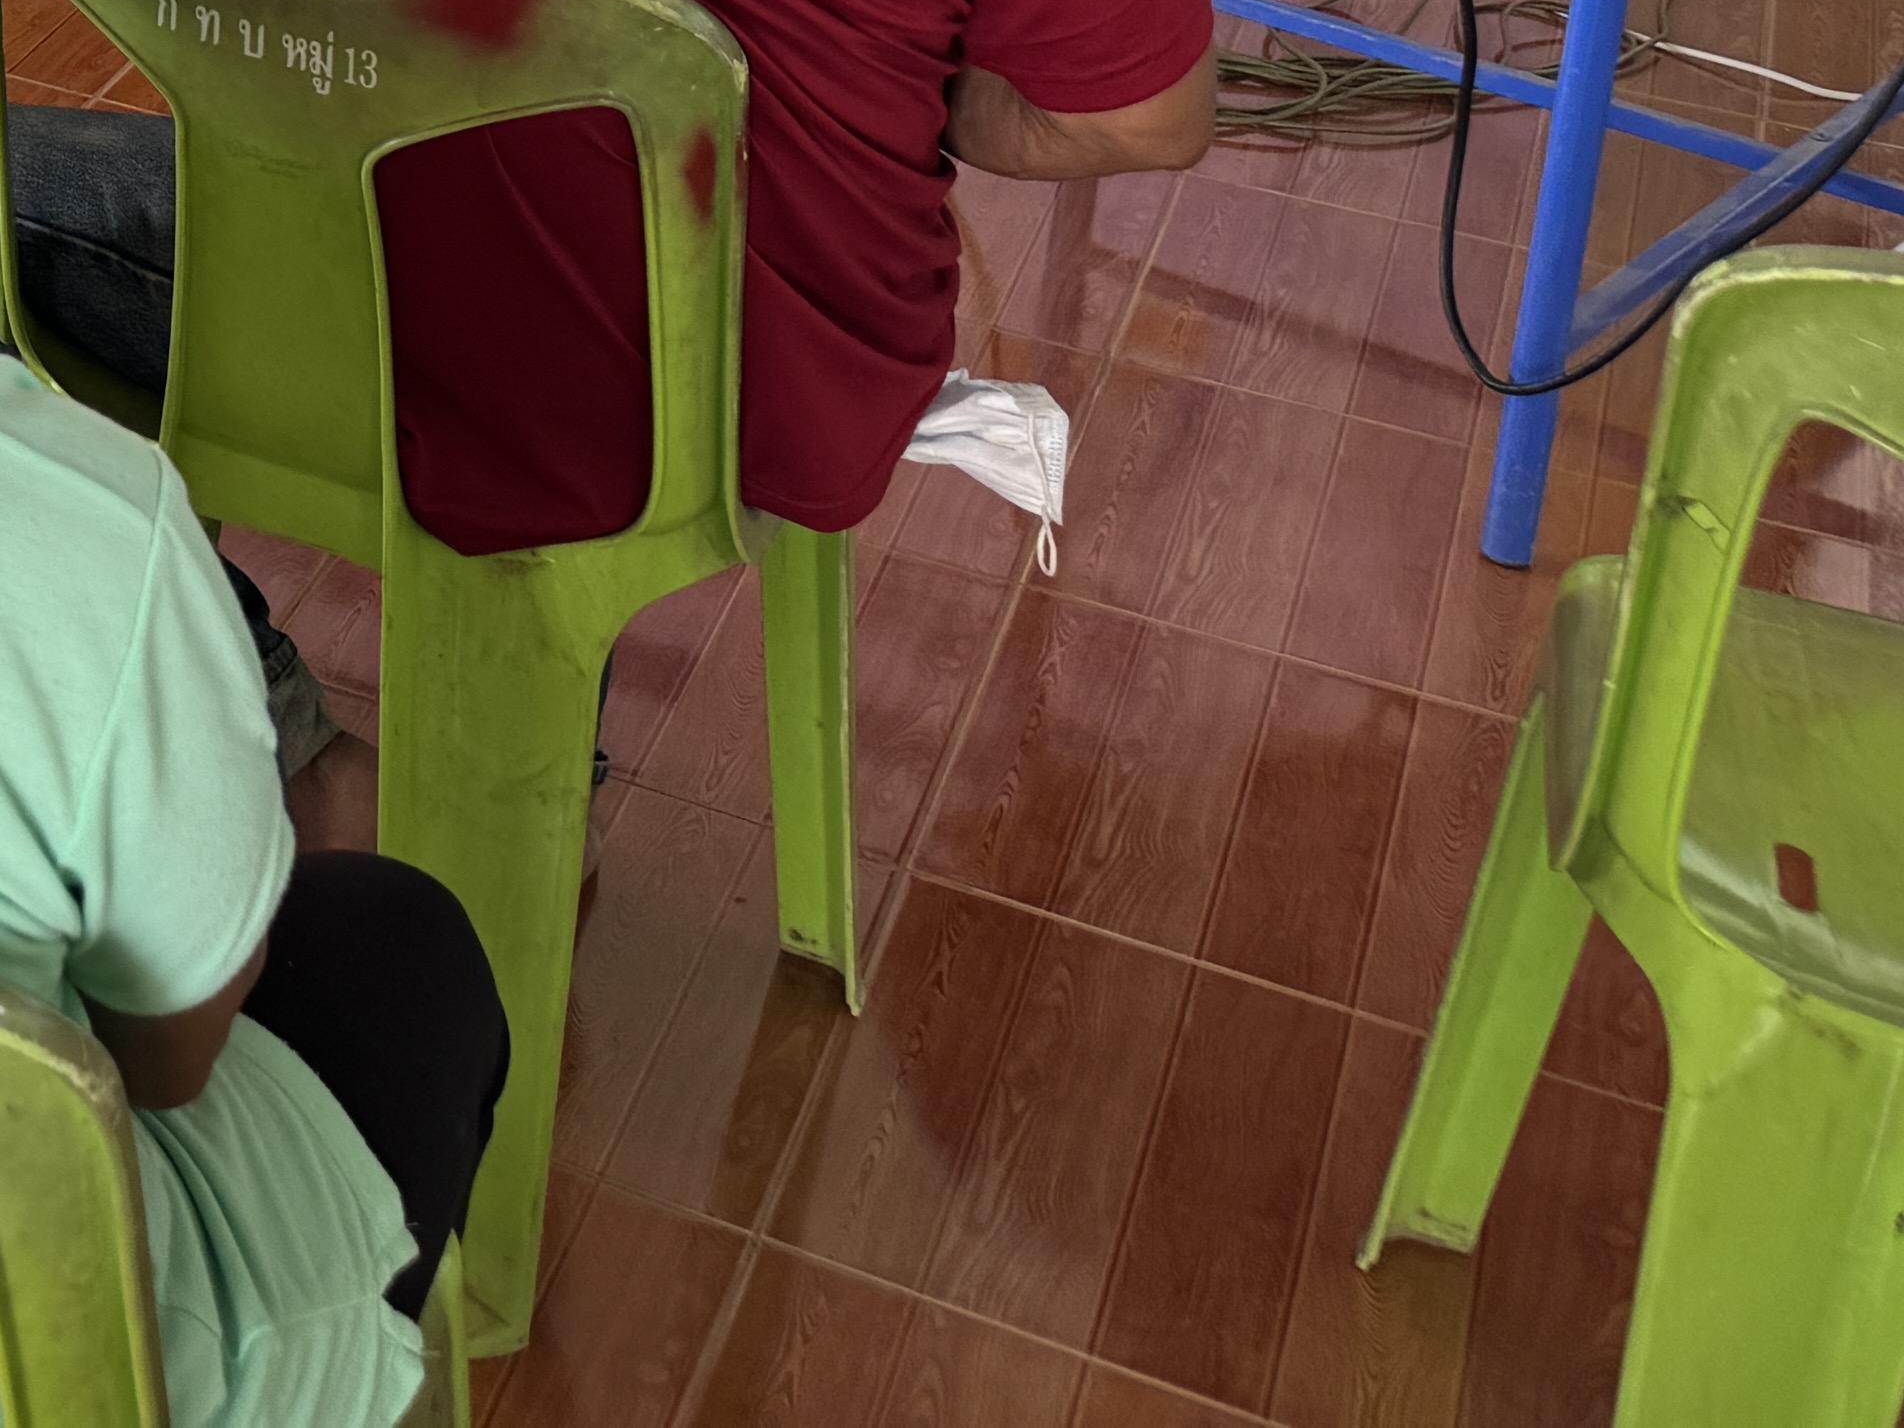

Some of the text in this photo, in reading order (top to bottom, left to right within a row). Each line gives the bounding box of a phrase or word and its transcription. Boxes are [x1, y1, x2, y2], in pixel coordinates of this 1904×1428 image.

[195, 5, 221, 46] ท
[238, 19, 265, 59] บ
[281, 30, 334, 96] หมู่
[343, 47, 379, 89] 13
